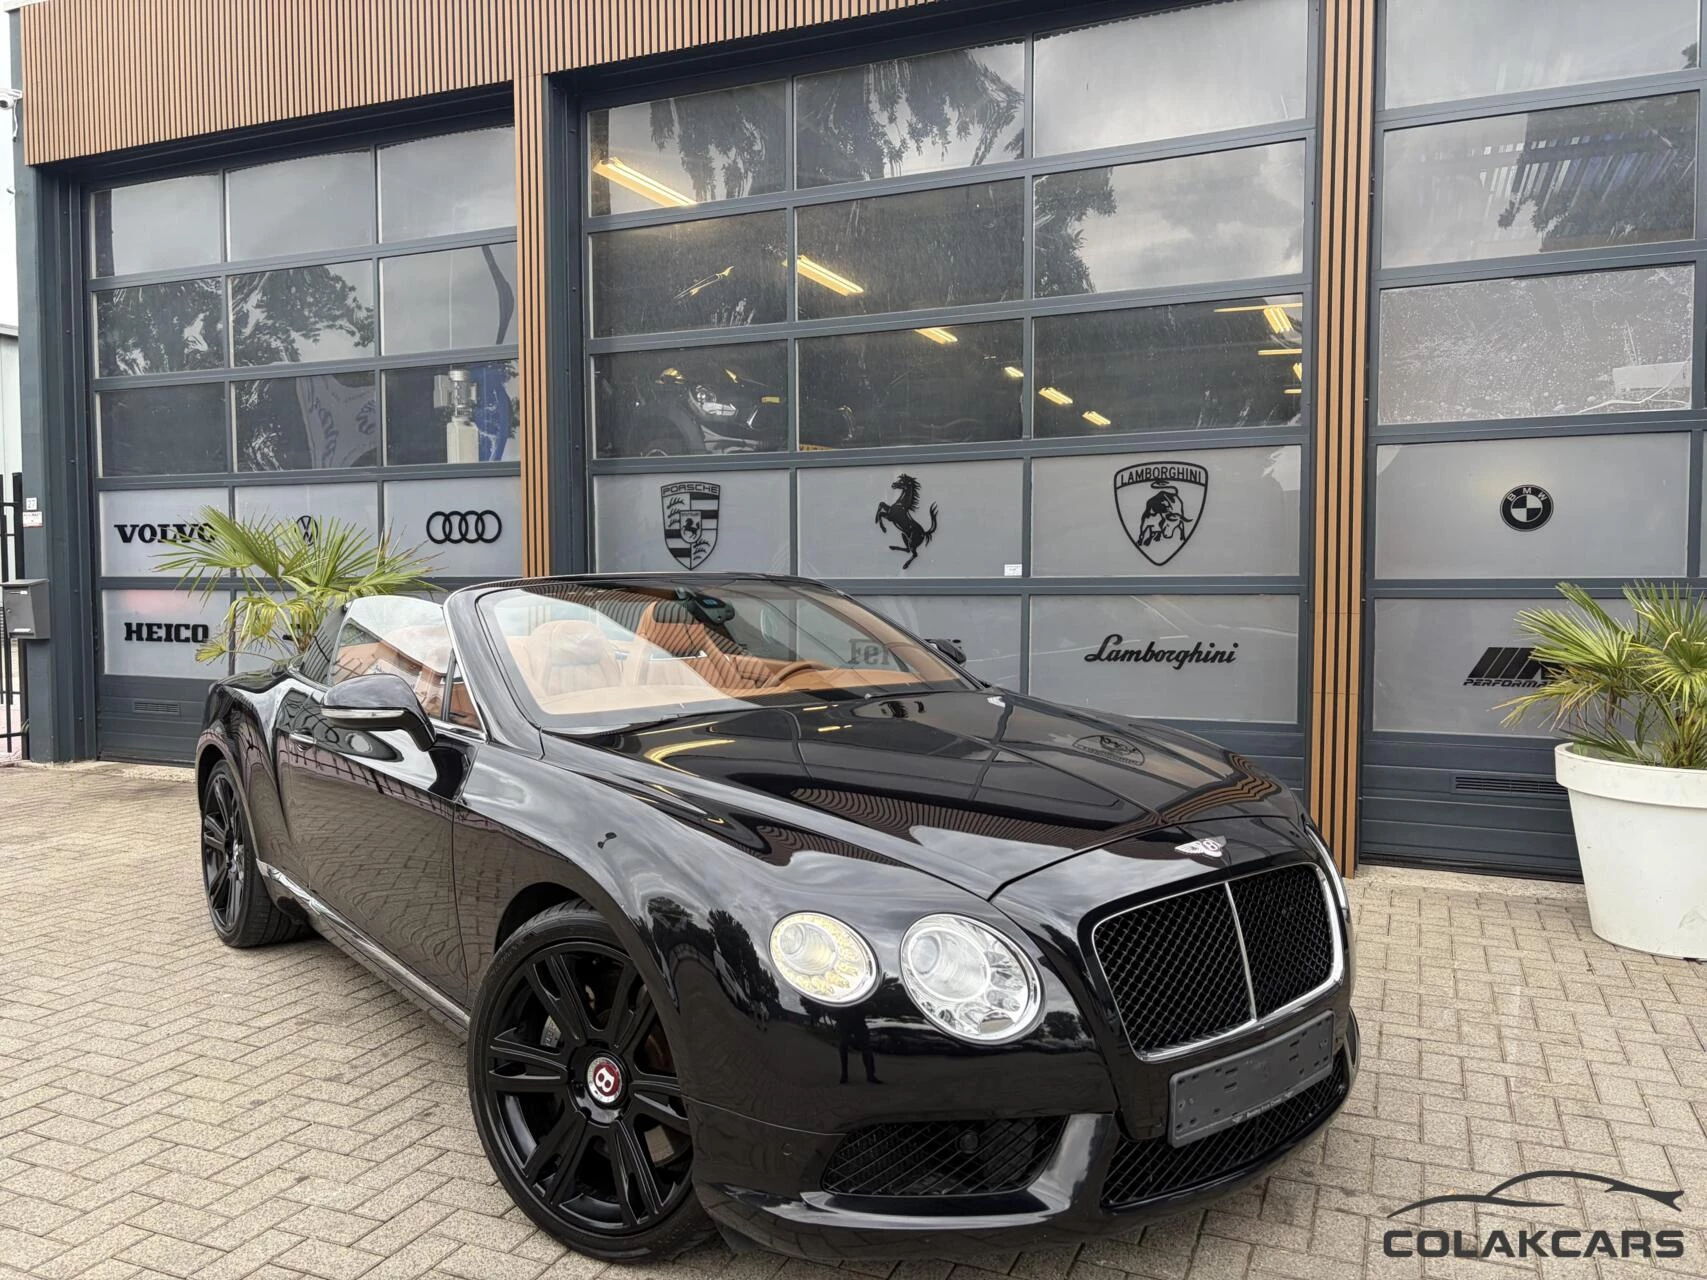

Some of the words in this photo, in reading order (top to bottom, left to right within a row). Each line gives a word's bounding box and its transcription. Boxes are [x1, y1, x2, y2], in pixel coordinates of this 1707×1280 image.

[1120, 466, 1202, 486] LAMBORGHINI
[662, 484, 718, 495] PORSCHE
[1507, 487, 1548, 502] BMW
[114, 523, 216, 543] VOLVO
[124, 622, 209, 643] HEICO
[1084, 634, 1239, 670] Lamborghini
